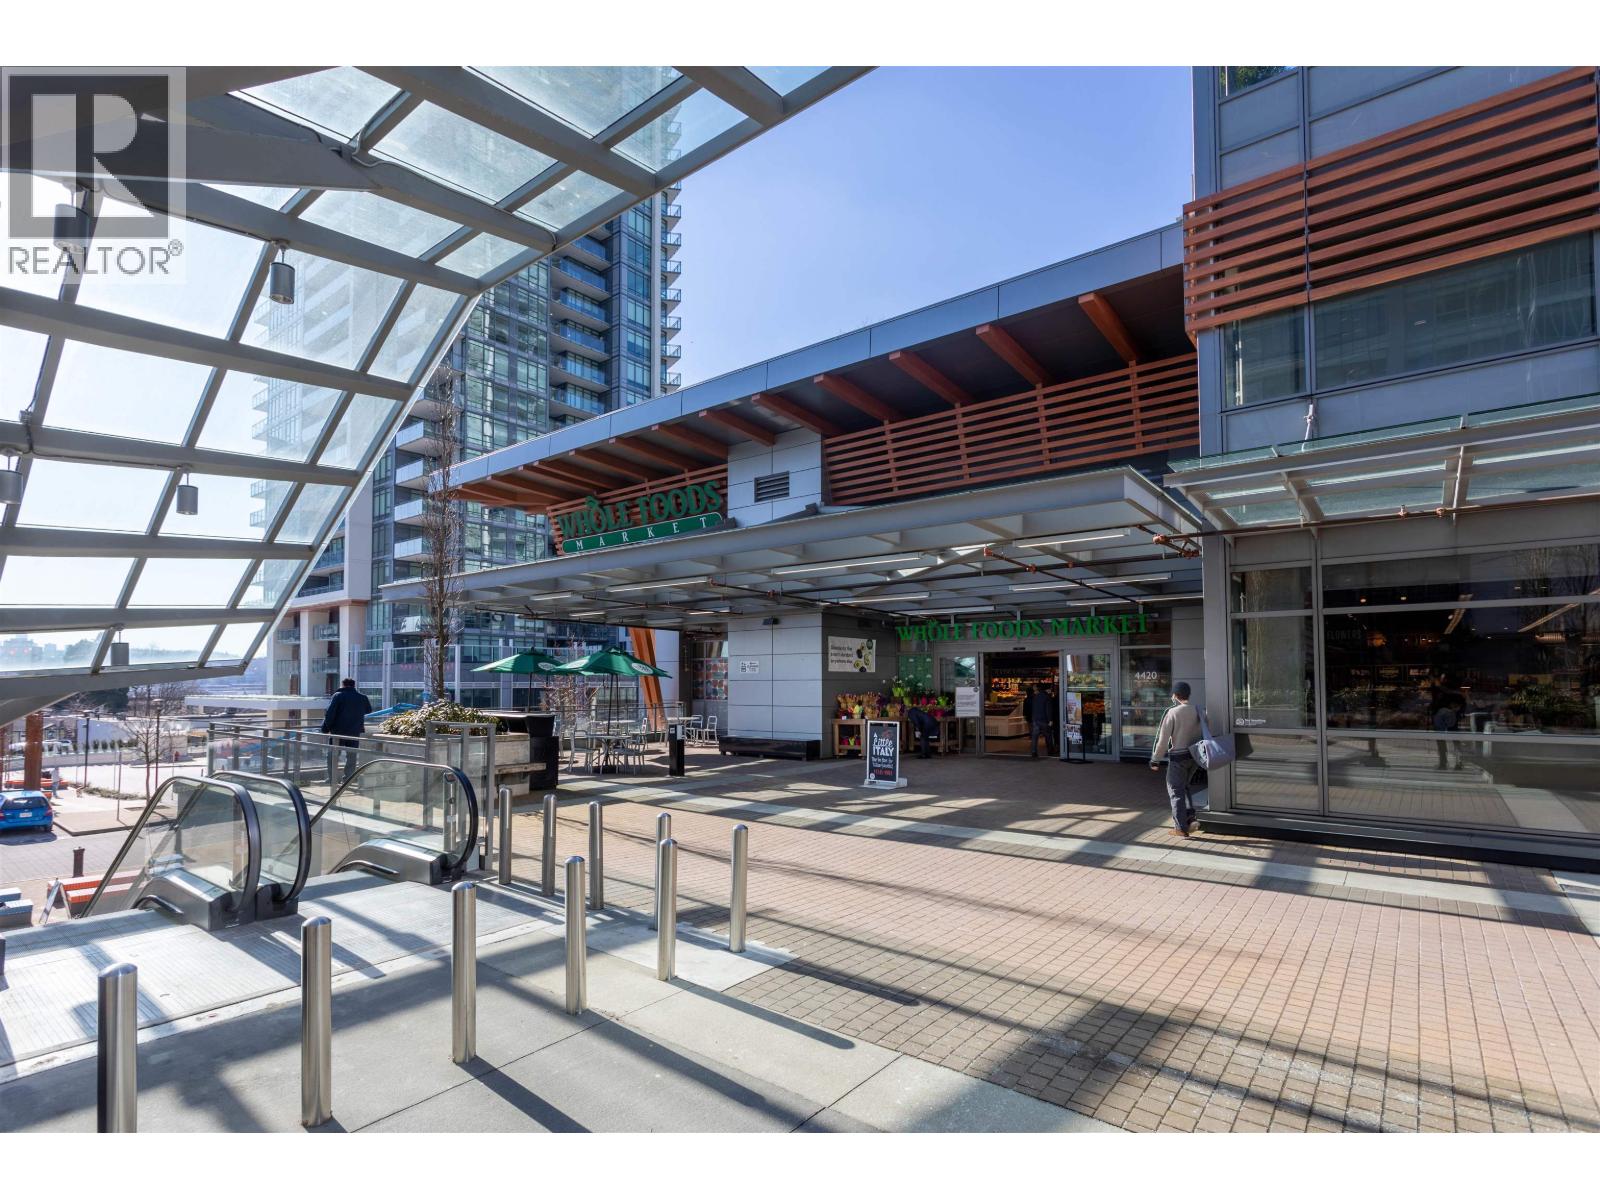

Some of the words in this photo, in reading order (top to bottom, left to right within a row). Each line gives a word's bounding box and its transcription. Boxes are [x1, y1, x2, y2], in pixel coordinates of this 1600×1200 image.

[557, 495, 634, 539] WHOLE
[635, 480, 723, 524] FOODS
[575, 517, 709, 551] MARKET
[896, 617, 966, 641] WHOLE
[972, 619, 1044, 640] FOODS
[1051, 614, 1149, 637] MARKET
[1134, 671, 1158, 680] 4420
[872, 746, 895, 757] ITALY
